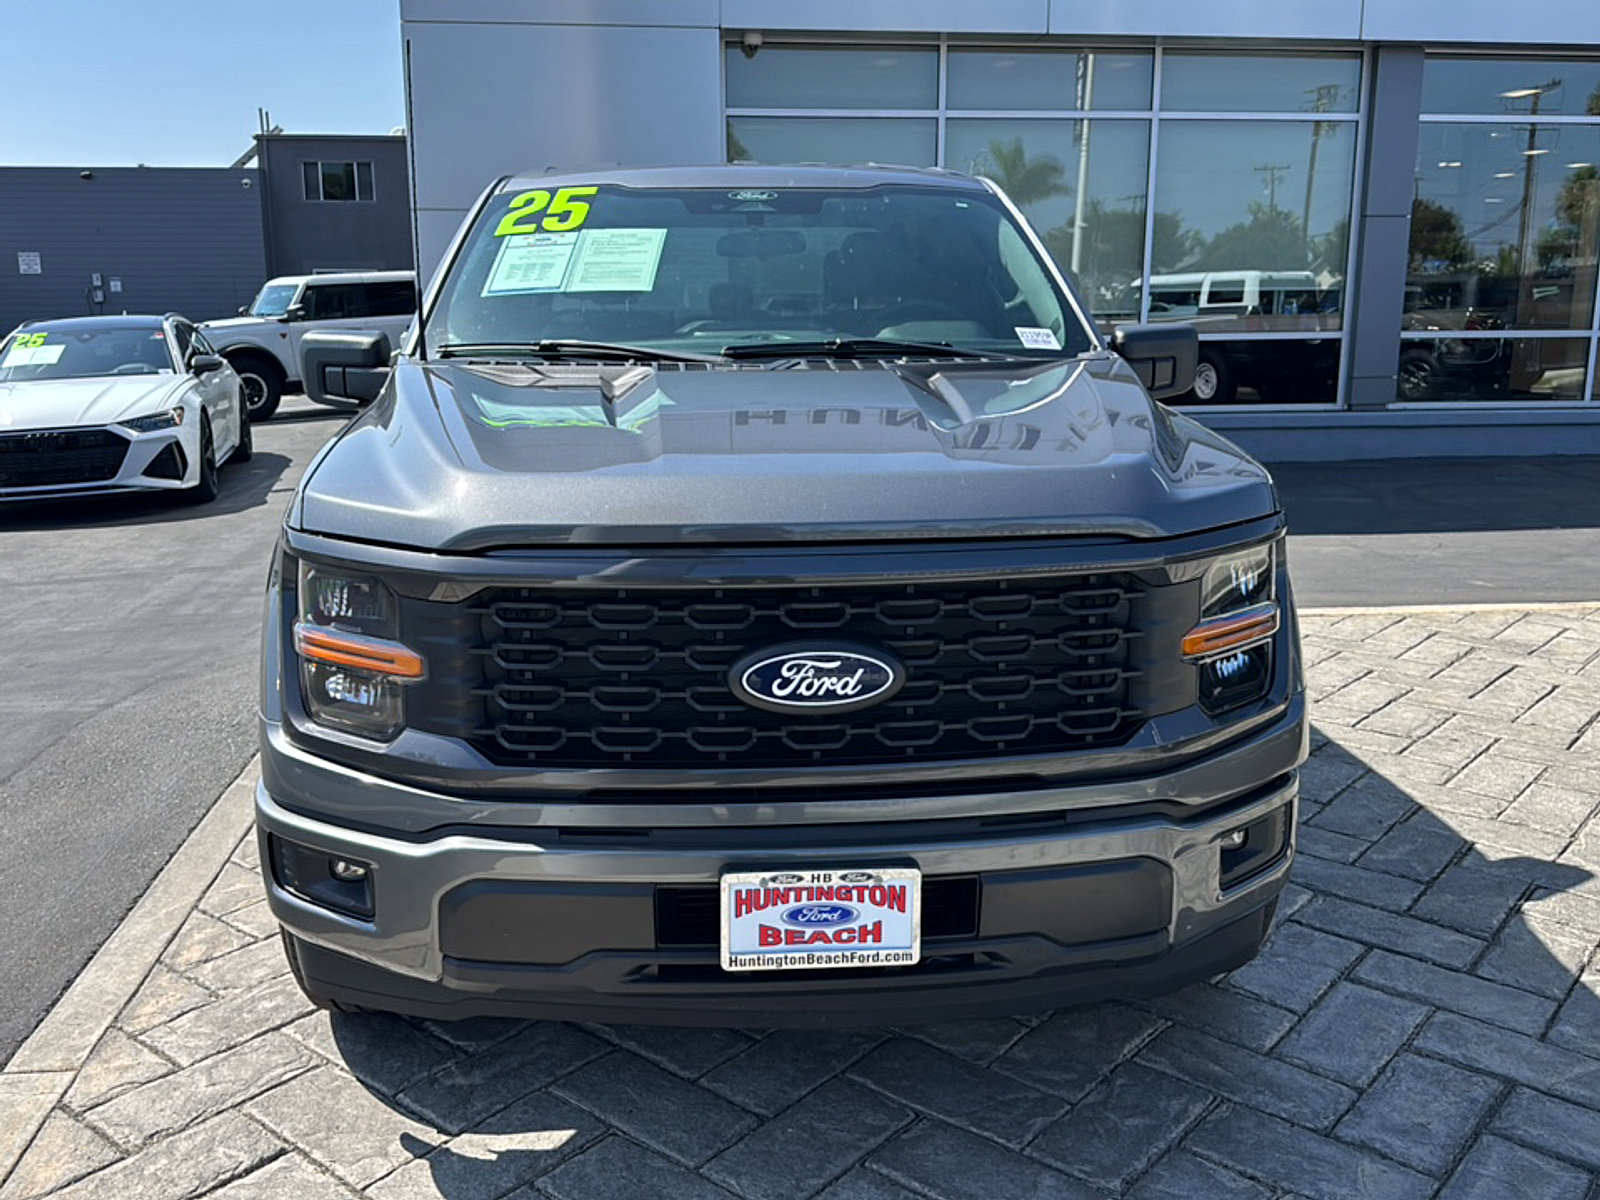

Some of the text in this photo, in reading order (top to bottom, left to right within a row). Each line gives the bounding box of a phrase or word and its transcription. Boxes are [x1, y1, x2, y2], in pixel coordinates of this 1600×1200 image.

[494, 187, 598, 236] 25
[15, 333, 48, 348] 25
[772, 659, 864, 696] Ford
[810, 873, 833, 884] HB
[735, 885, 906, 918] HUNTINGTON
[798, 906, 841, 922] Ford
[759, 920, 883, 947] BEACH
[729, 951, 913, 969] HuntingtonBeachFord.com
